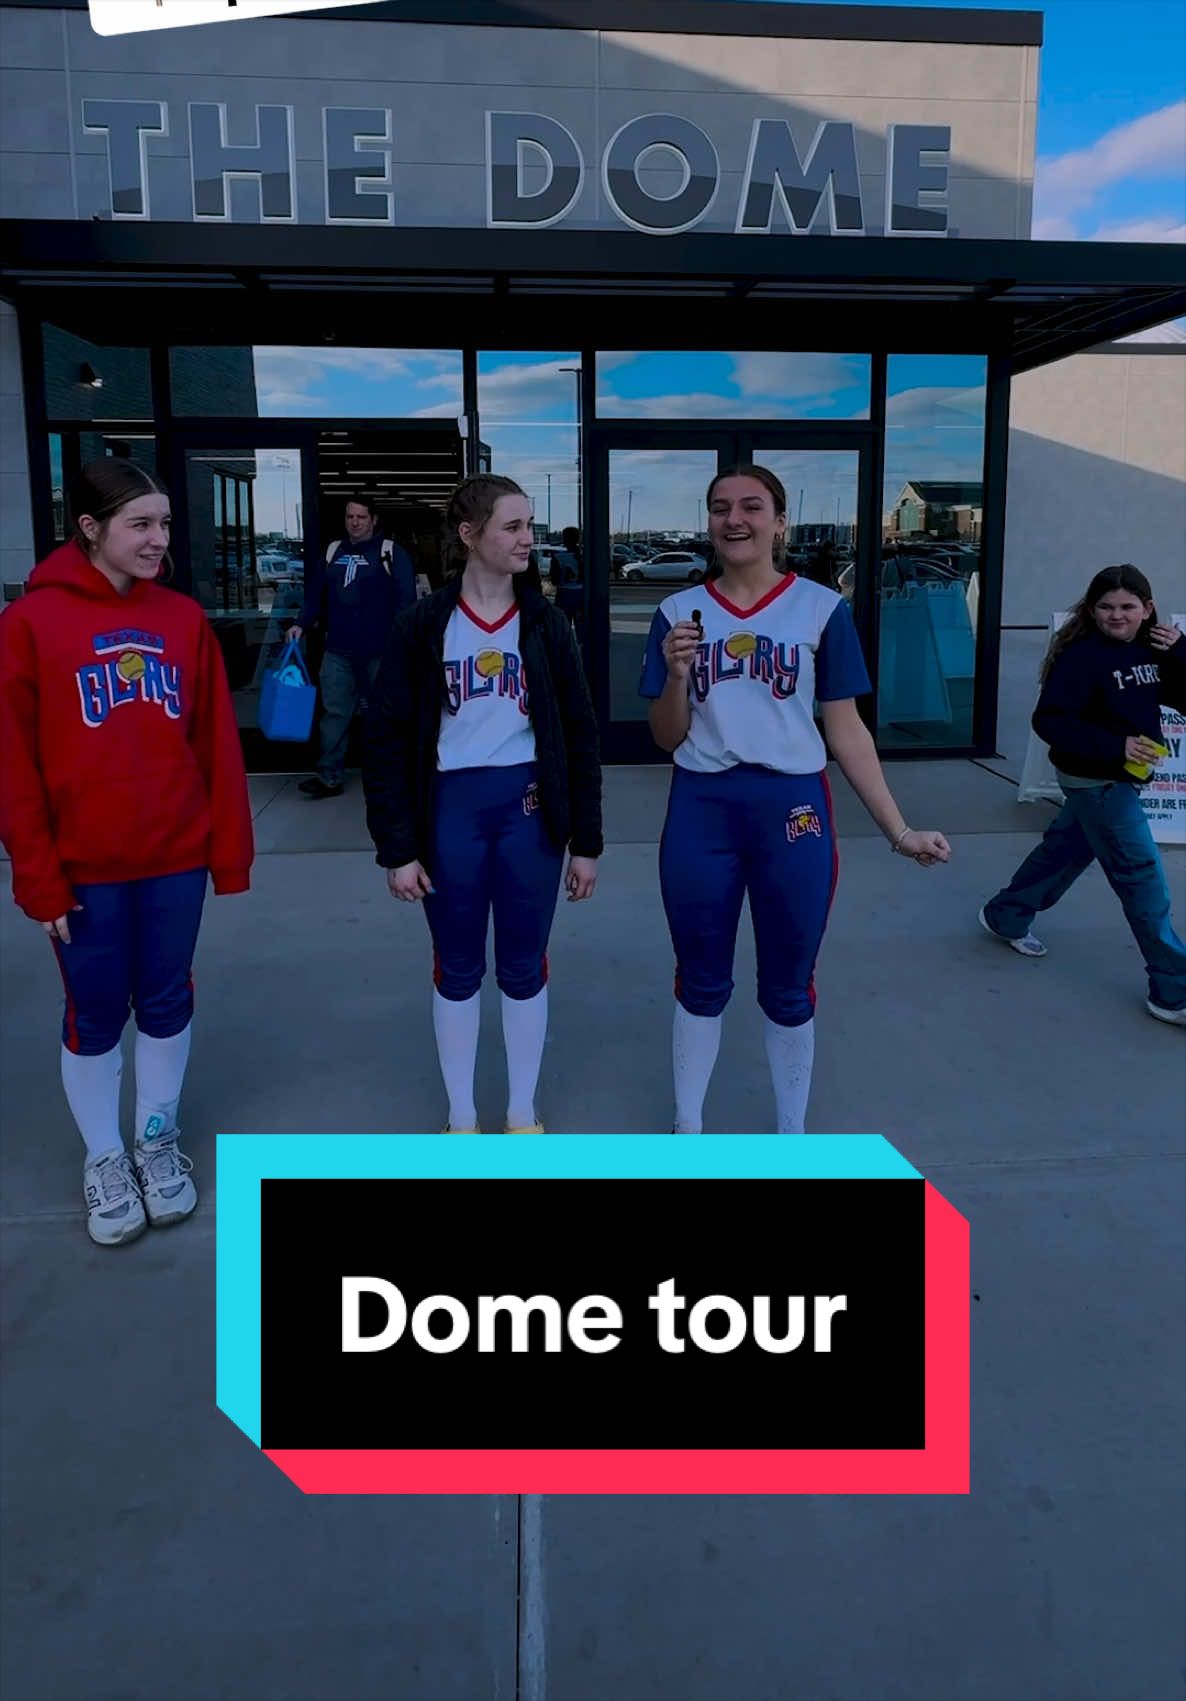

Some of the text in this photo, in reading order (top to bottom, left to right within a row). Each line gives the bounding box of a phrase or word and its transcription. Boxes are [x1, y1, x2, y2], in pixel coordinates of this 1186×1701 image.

[81, 99, 952, 236] THE DOME
[75, 650, 182, 728] GLORY
[690, 632, 800, 702] GLORY
